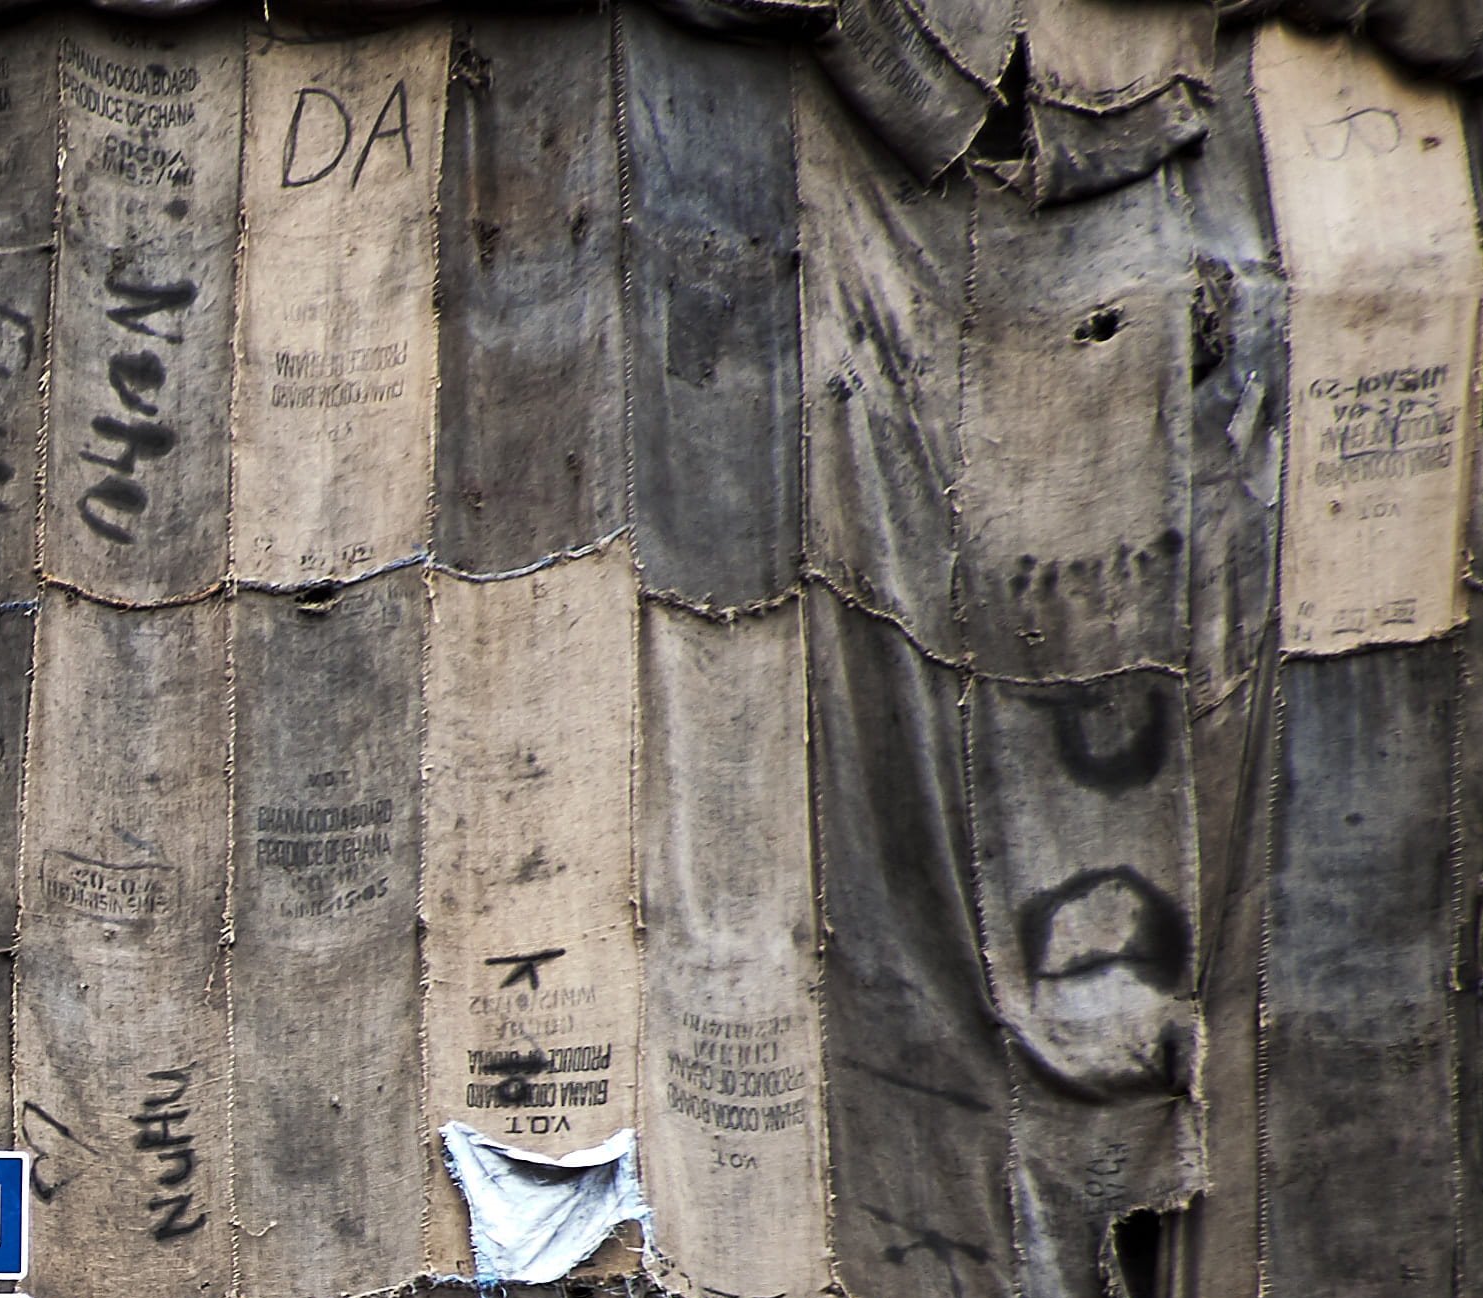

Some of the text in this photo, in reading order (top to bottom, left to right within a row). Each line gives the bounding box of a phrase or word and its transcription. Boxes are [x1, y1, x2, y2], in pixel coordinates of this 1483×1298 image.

[104, 62, 148, 94] COCOA
[148, 65, 199, 96] BOARD
[63, 72, 123, 124] PRODUCE
[148, 102, 196, 128] GHANA
[280, 79, 413, 189] DA
[256, 799, 393, 834] GHANA COCOA BOARD
[256, 838, 324, 868] PRODUCE
[343, 832, 391, 864] GHANA
[547, 1043, 612, 1074] PRODUCE
[560, 1080, 609, 1107] GHANA
[740, 1066, 806, 1098] PRODUCE
[714, 1104, 760, 1132] COCOA
